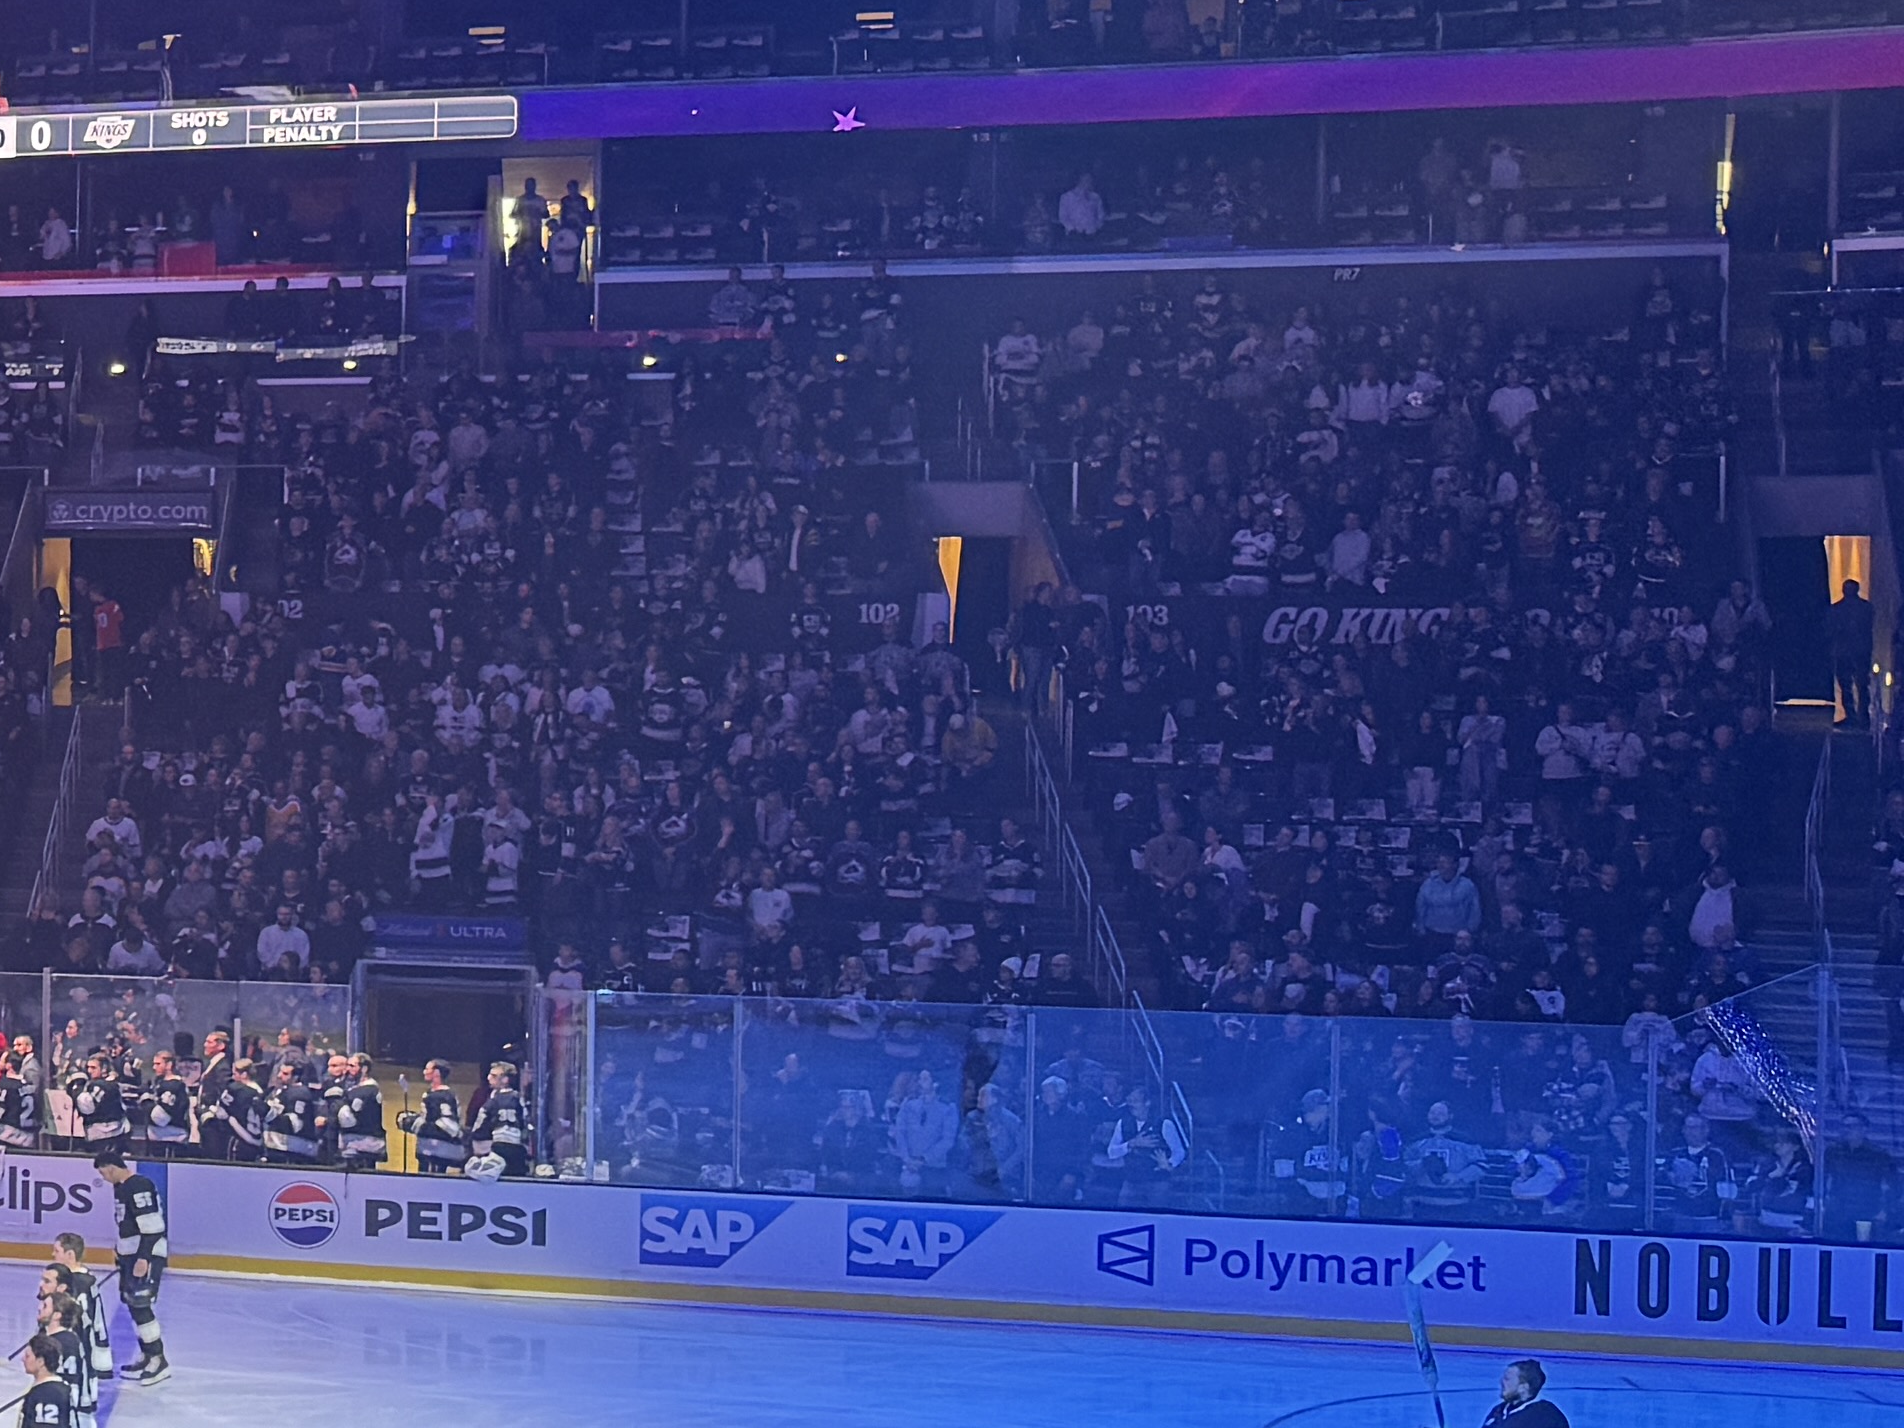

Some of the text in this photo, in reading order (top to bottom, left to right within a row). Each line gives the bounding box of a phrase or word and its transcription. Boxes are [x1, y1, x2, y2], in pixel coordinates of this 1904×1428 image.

[171, 110, 230, 129] SHOTS
[269, 105, 338, 124] PLAYER
[30, 120, 51, 150] 0
[89, 118, 132, 138] KINGS
[192, 128, 206, 145] 0
[263, 123, 342, 142] PENALTY
[1333, 268, 1361, 282] PR7
[76, 500, 209, 525] crypto.com
[857, 603, 900, 625] 102
[1262, 606, 1329, 653] GO
[450, 924, 507, 939] ULTRA
[273, 1204, 336, 1226] PEPSI
[364, 1198, 549, 1247] PEPSI
[640, 1205, 756, 1256] SAP
[848, 1216, 966, 1269] SAP
[1184, 1237, 1487, 1293] Polymarket
[1574, 1237, 1904, 1334] NOBULL
[35, 1403, 60, 1424] 12
